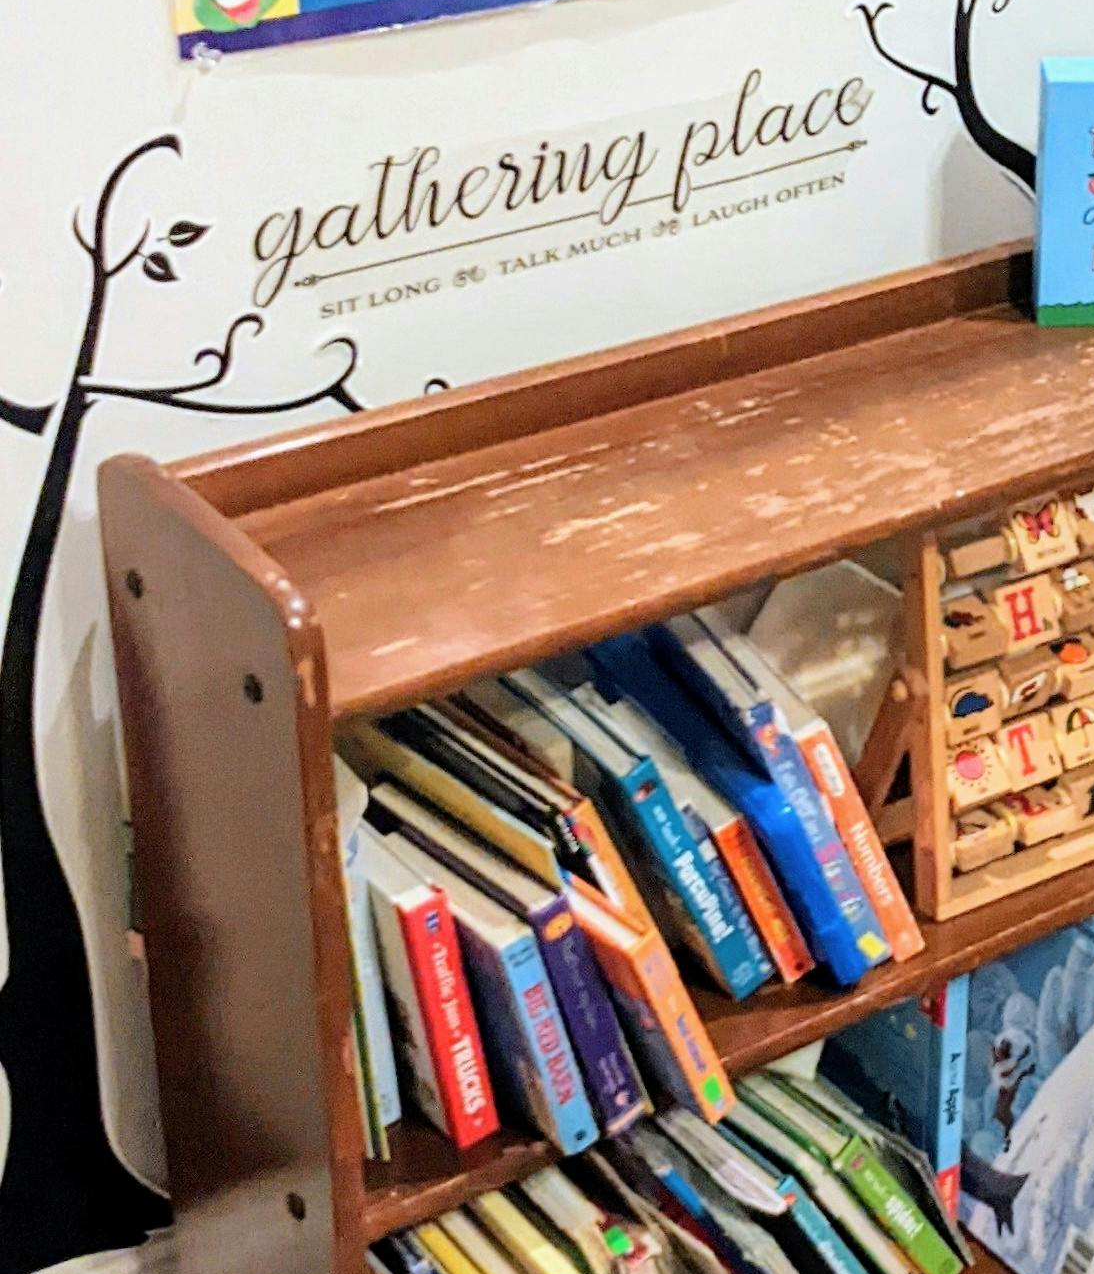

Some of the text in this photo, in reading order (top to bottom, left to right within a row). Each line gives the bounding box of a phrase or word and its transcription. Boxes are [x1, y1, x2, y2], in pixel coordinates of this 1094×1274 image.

[252, 68, 874, 309] gathering place
[320, 171, 846, 319] SIT LONG TALK MUCH LAUGH OFTEN
[1005, 586, 1042, 641] H
[1008, 724, 1038, 777] T
[851, 821, 894, 906] Numbers
[451, 1034, 487, 1115] TRUCKS
